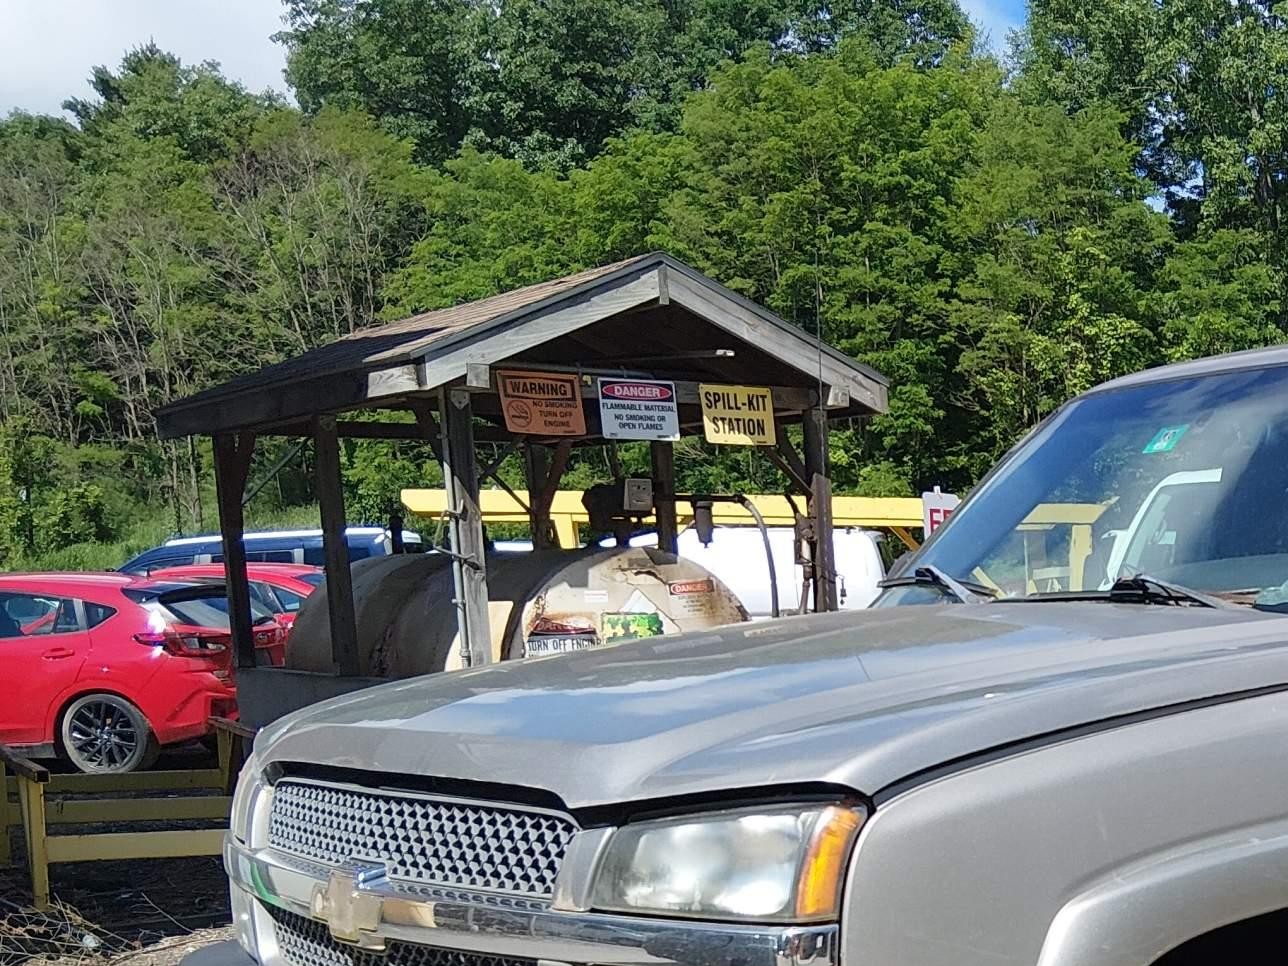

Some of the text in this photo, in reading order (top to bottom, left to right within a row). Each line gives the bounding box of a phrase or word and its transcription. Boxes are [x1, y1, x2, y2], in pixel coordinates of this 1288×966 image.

[510, 380, 568, 396] WARNING
[614, 385, 660, 397] DANGER
[532, 400, 577, 409] NO SMOKING
[704, 391, 767, 412] SPILL-KIT
[602, 403, 675, 412] FLAMMABLE MATERIAL
[539, 410, 557, 418] TURN
[625, 414, 656, 422] SMOKING
[544, 420, 571, 428] ENGINE
[712, 416, 766, 436] STATION
